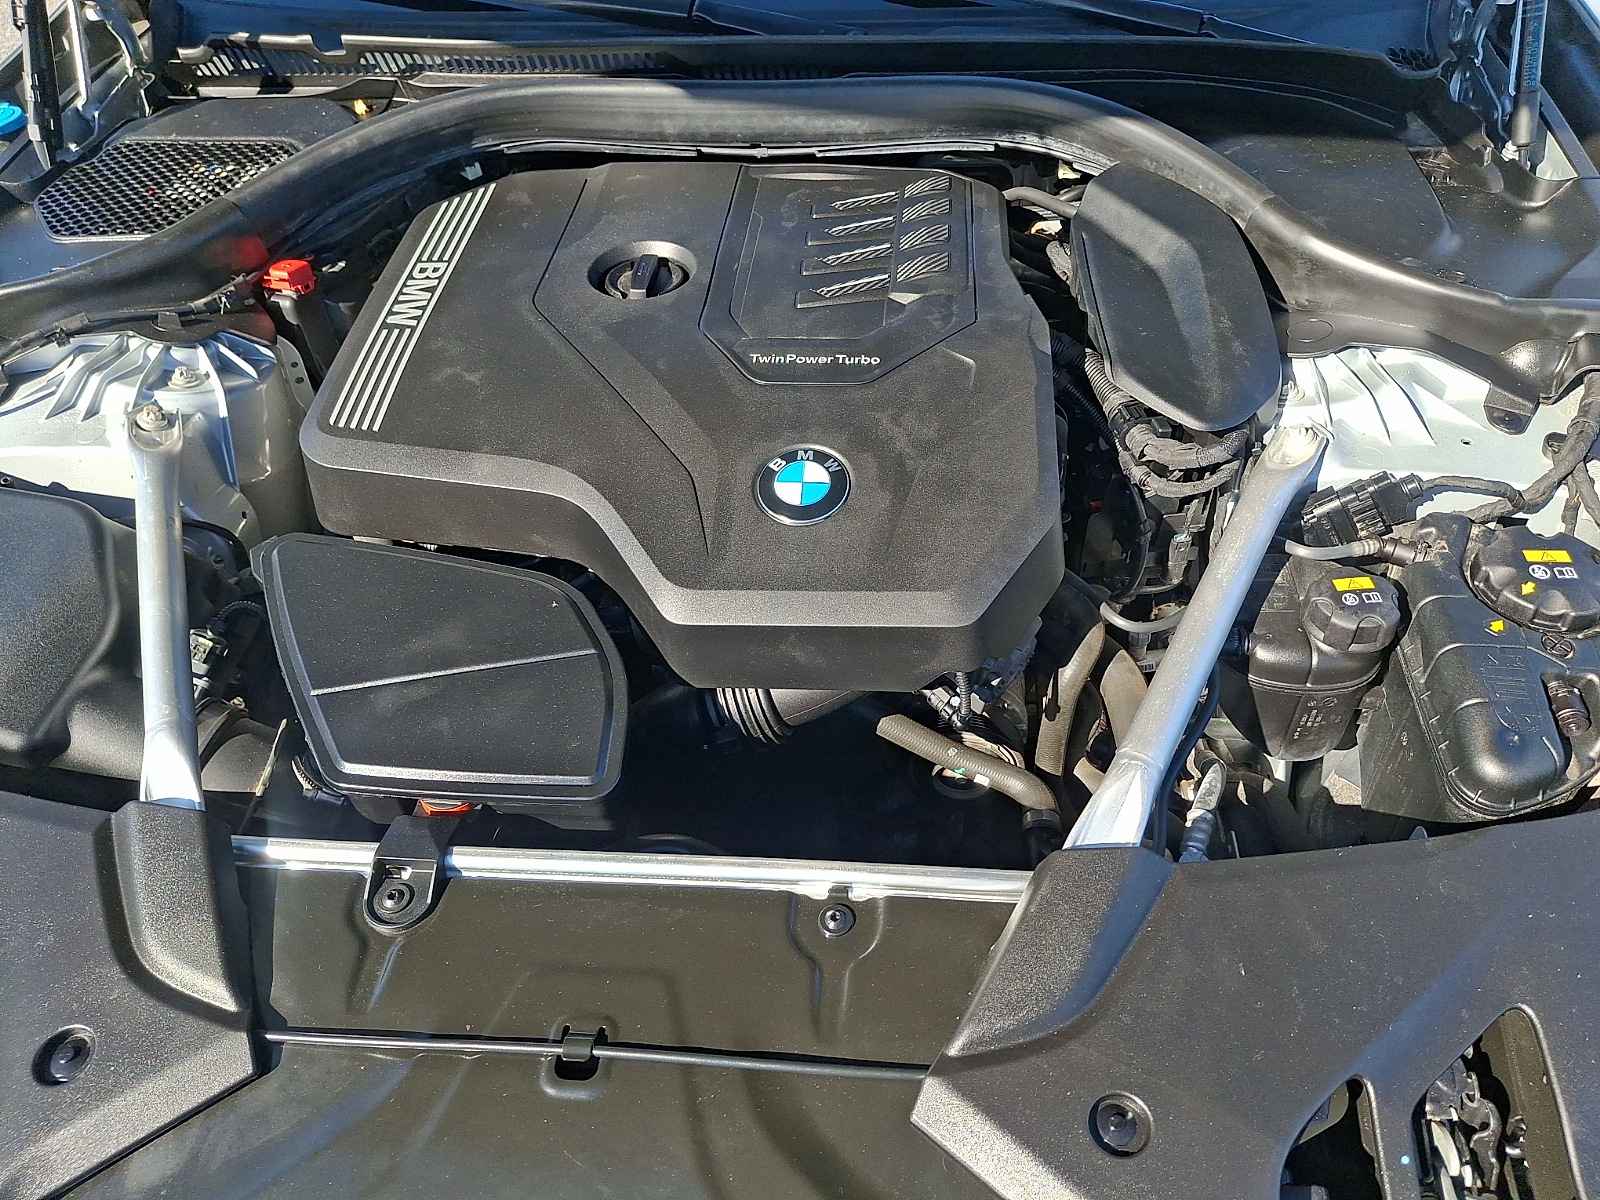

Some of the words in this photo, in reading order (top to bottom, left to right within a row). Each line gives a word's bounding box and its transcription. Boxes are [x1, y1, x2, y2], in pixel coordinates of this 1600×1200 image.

[385, 262, 449, 327] BMW
[835, 354, 881, 365] Turbo
[768, 450, 841, 473] BMW
